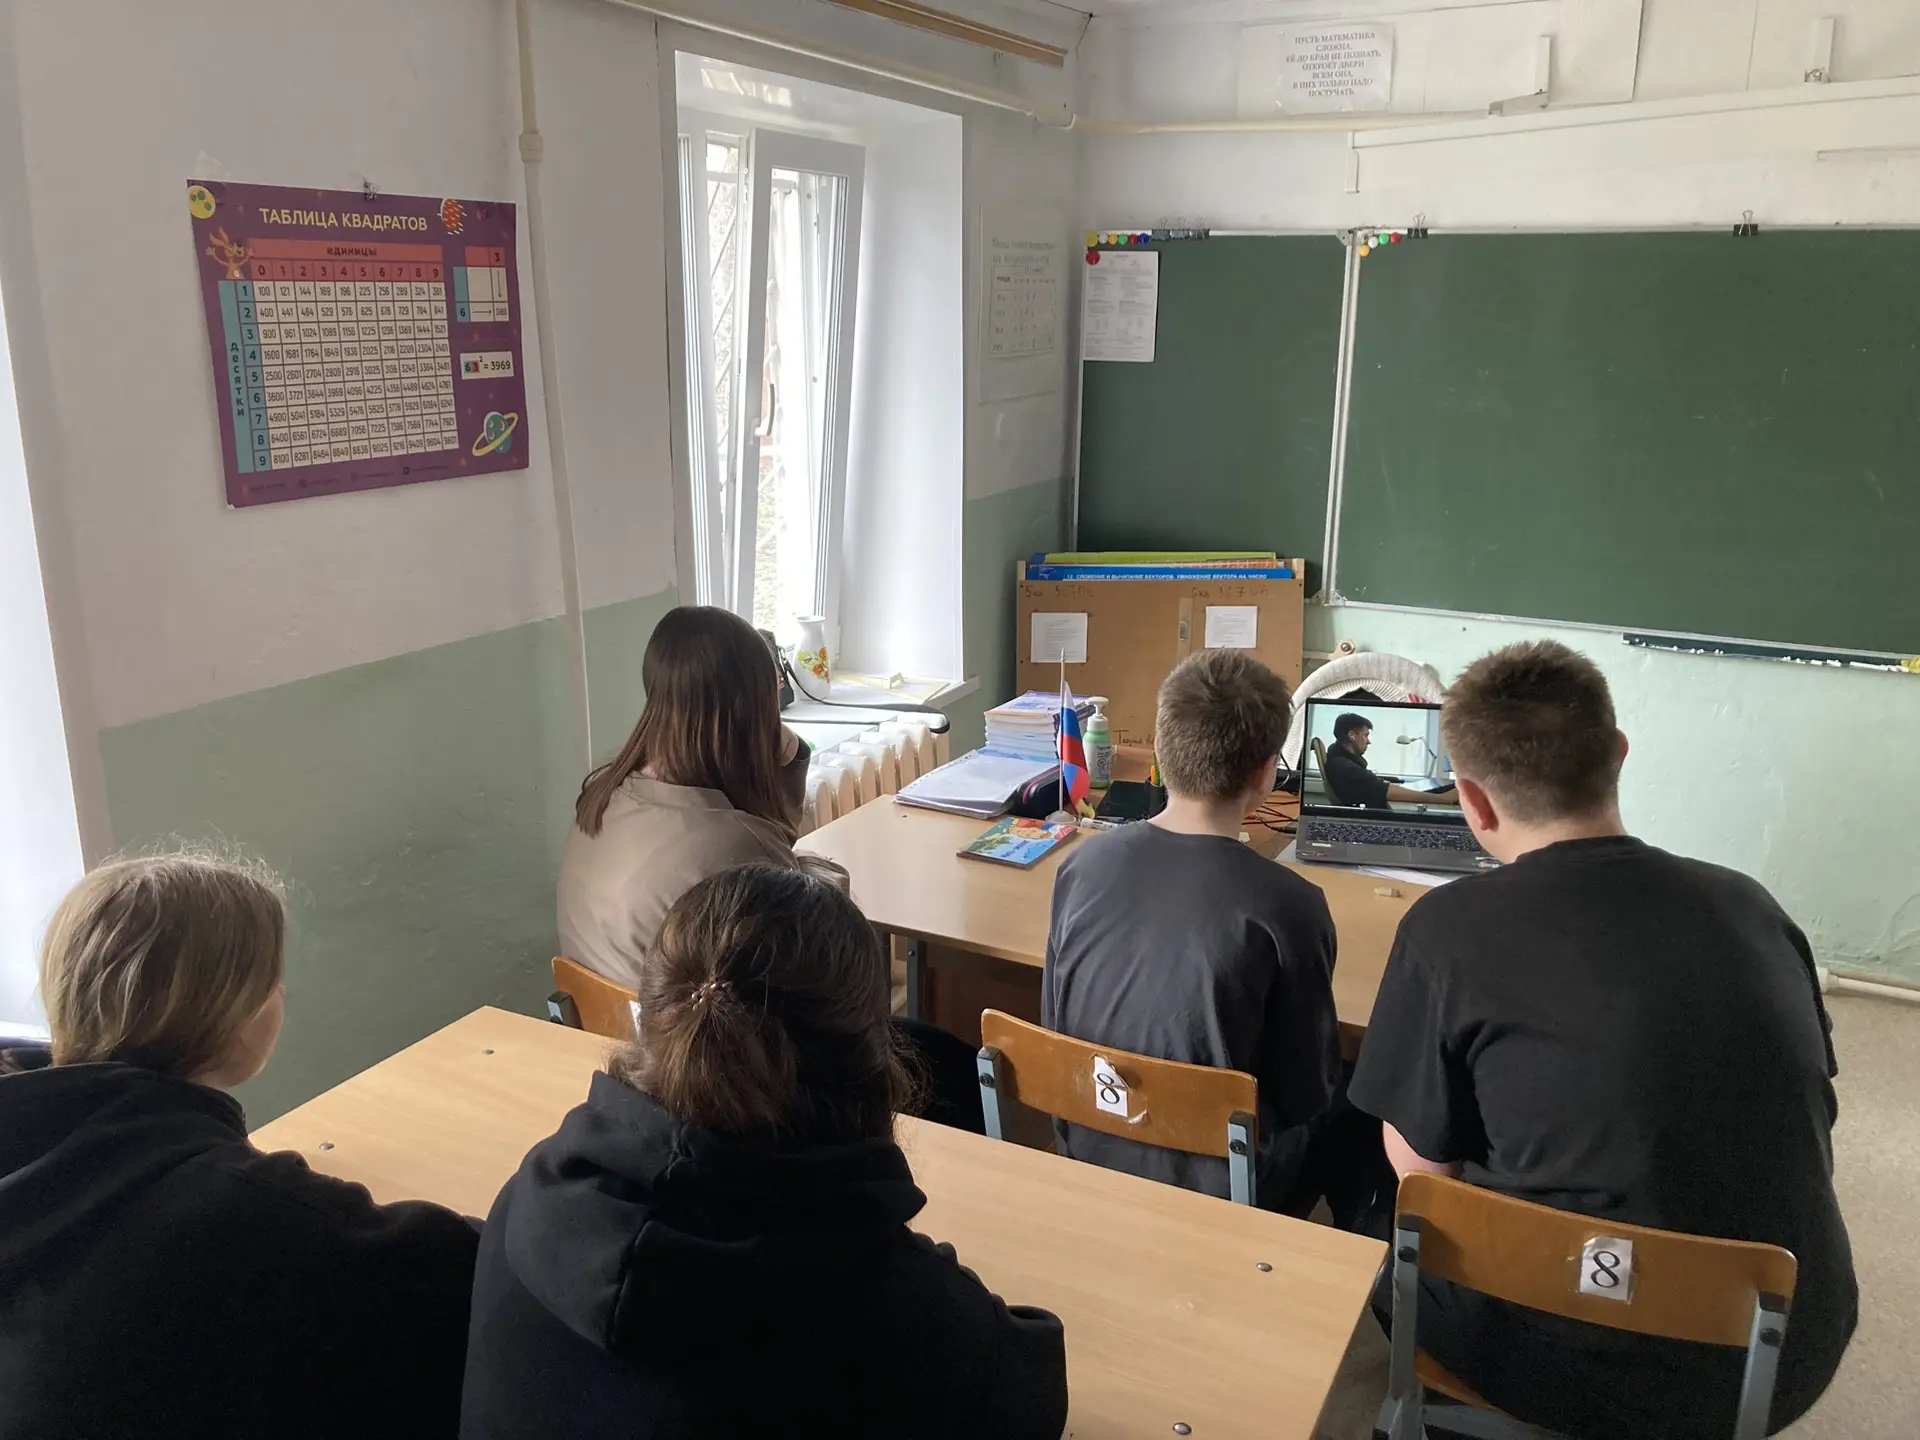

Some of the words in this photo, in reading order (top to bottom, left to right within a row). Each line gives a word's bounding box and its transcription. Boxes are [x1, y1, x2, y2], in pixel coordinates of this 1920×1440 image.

[1295, 36, 1319, 44] ПУСТЬ
[1321, 32, 1375, 43] МАТЕМАТИКА
[1309, 53, 1330, 61] КРАЯ
[1302, 62, 1337, 71] ОТКРОЕТ
[1318, 80, 1349, 88] ТОЛЬКО
[259, 207, 338, 228] ТАБЛИЦА
[342, 213, 427, 232] КВАДРАТОВ
[326, 246, 377, 257] единицы
[258, 265, 265, 275] 0
[300, 266, 307, 276] 2
[321, 266, 327, 277] 3
[340, 267, 347, 277] 4
[360, 267, 367, 277] 5
[379, 267, 386, 277] 6
[398, 268, 403, 277] 7
[416, 268, 422, 277] 8
[432, 268, 439, 278] 9
[258, 286, 270, 296] 100
[279, 286, 290, 296] 121
[244, 308, 251, 318] 2
[259, 307, 274, 317] 400
[281, 307, 293, 317] 441
[460, 308, 466, 317] 6
[247, 329, 253, 340] 3
[262, 328, 276, 338] 900
[284, 327, 296, 338] 961
[249, 350, 256, 360] 4
[263, 349, 280, 359] 1600
[285, 348, 299, 359] 1681
[491, 360, 511, 370] 3969
[252, 372, 258, 382] 5
[264, 370, 282, 381] 2500
[285, 369, 301, 379] 2601
[254, 393, 260, 403] 6
[266, 390, 284, 401] 3600
[288, 389, 303, 400] 3721
[256, 414, 262, 425] 7
[268, 411, 286, 422] 4900
[290, 409, 305, 420] 5041
[258, 435, 264, 445] 8
[270, 431, 288, 443] 6400
[292, 430, 307, 441] 6561
[260, 457, 266, 466] 9
[273, 453, 289, 464] 8100
[293, 450, 309, 462] 8281
[1096, 1073, 1120, 1104] 8
[1590, 1250, 1620, 1288] 8
